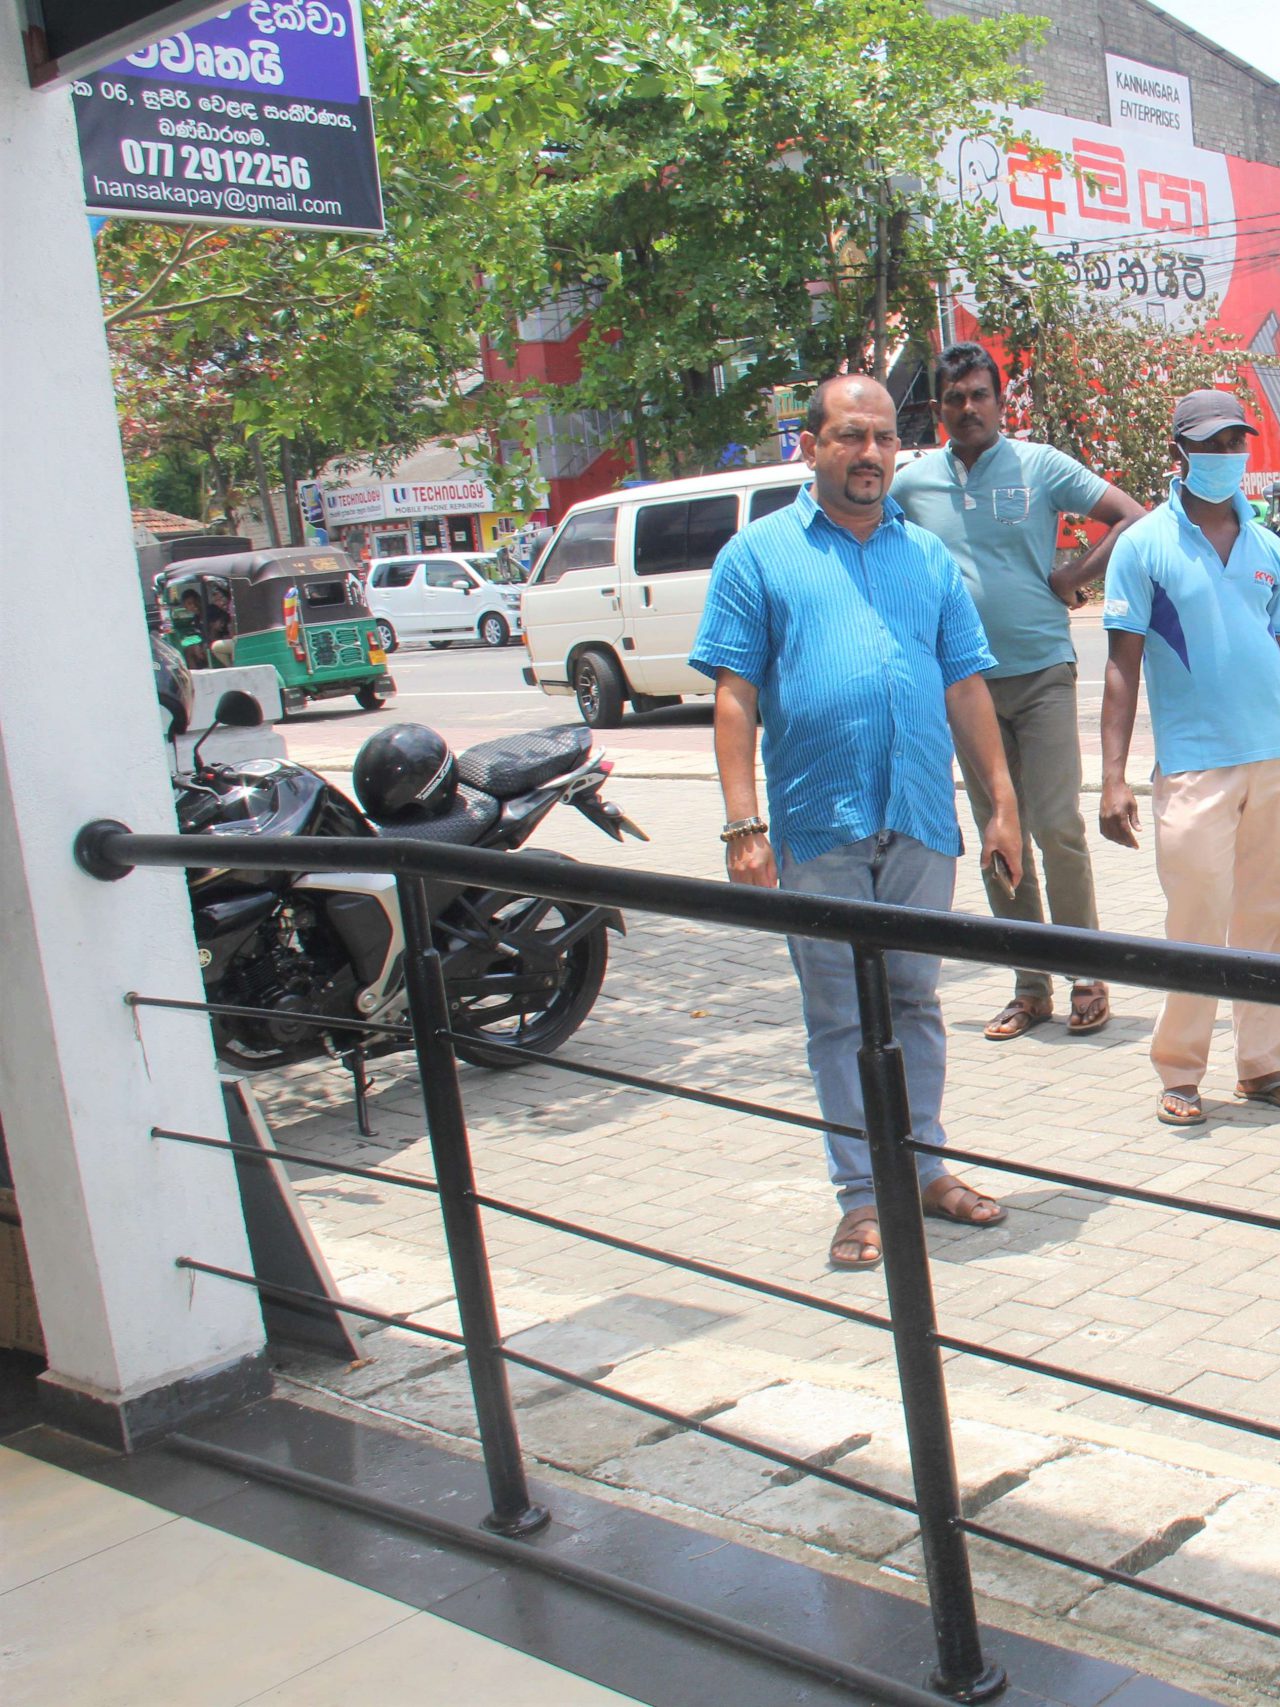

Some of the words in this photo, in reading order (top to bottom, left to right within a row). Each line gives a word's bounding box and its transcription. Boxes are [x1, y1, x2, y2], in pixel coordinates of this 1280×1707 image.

[101, 82, 134, 106] 06,
[142, 88, 191, 111] සුපිරි
[199, 95, 259, 120] වෙළඳ
[1116, 71, 1181, 104] KANNANGARA
[1120, 100, 1181, 130] ENTERPRISES
[120, 139, 174, 177] 077
[181, 145, 312, 190] 2912256
[94, 176, 342, 215] hansakapay@gmail.com
[395, 506, 421, 514] MOBILE
[423, 503, 448, 512] PHONE
[450, 501, 485, 510] REPAIRING
[412, 484, 485, 502] TECHNOLOGY
